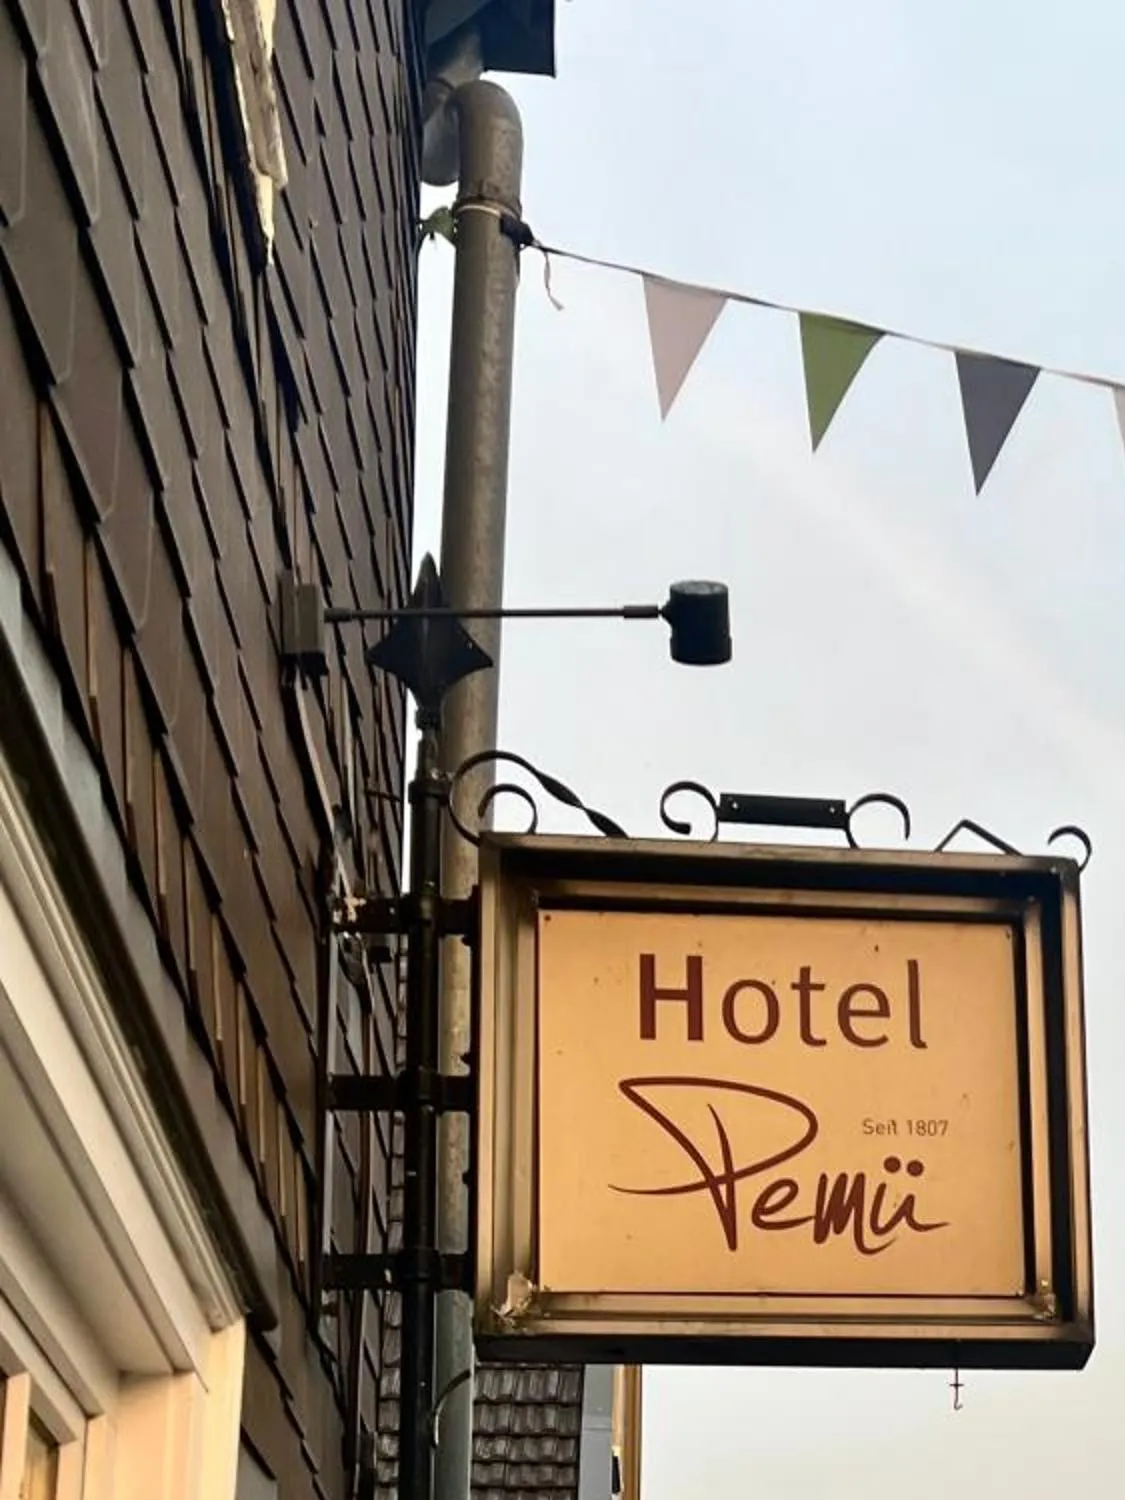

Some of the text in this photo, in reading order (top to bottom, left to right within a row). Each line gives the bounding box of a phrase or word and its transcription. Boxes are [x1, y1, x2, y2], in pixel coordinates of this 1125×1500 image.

[639, 953, 928, 1049] Hotel
[607, 1076, 950, 1255] Pemü
[862, 1117, 949, 1137] Seit 1807
